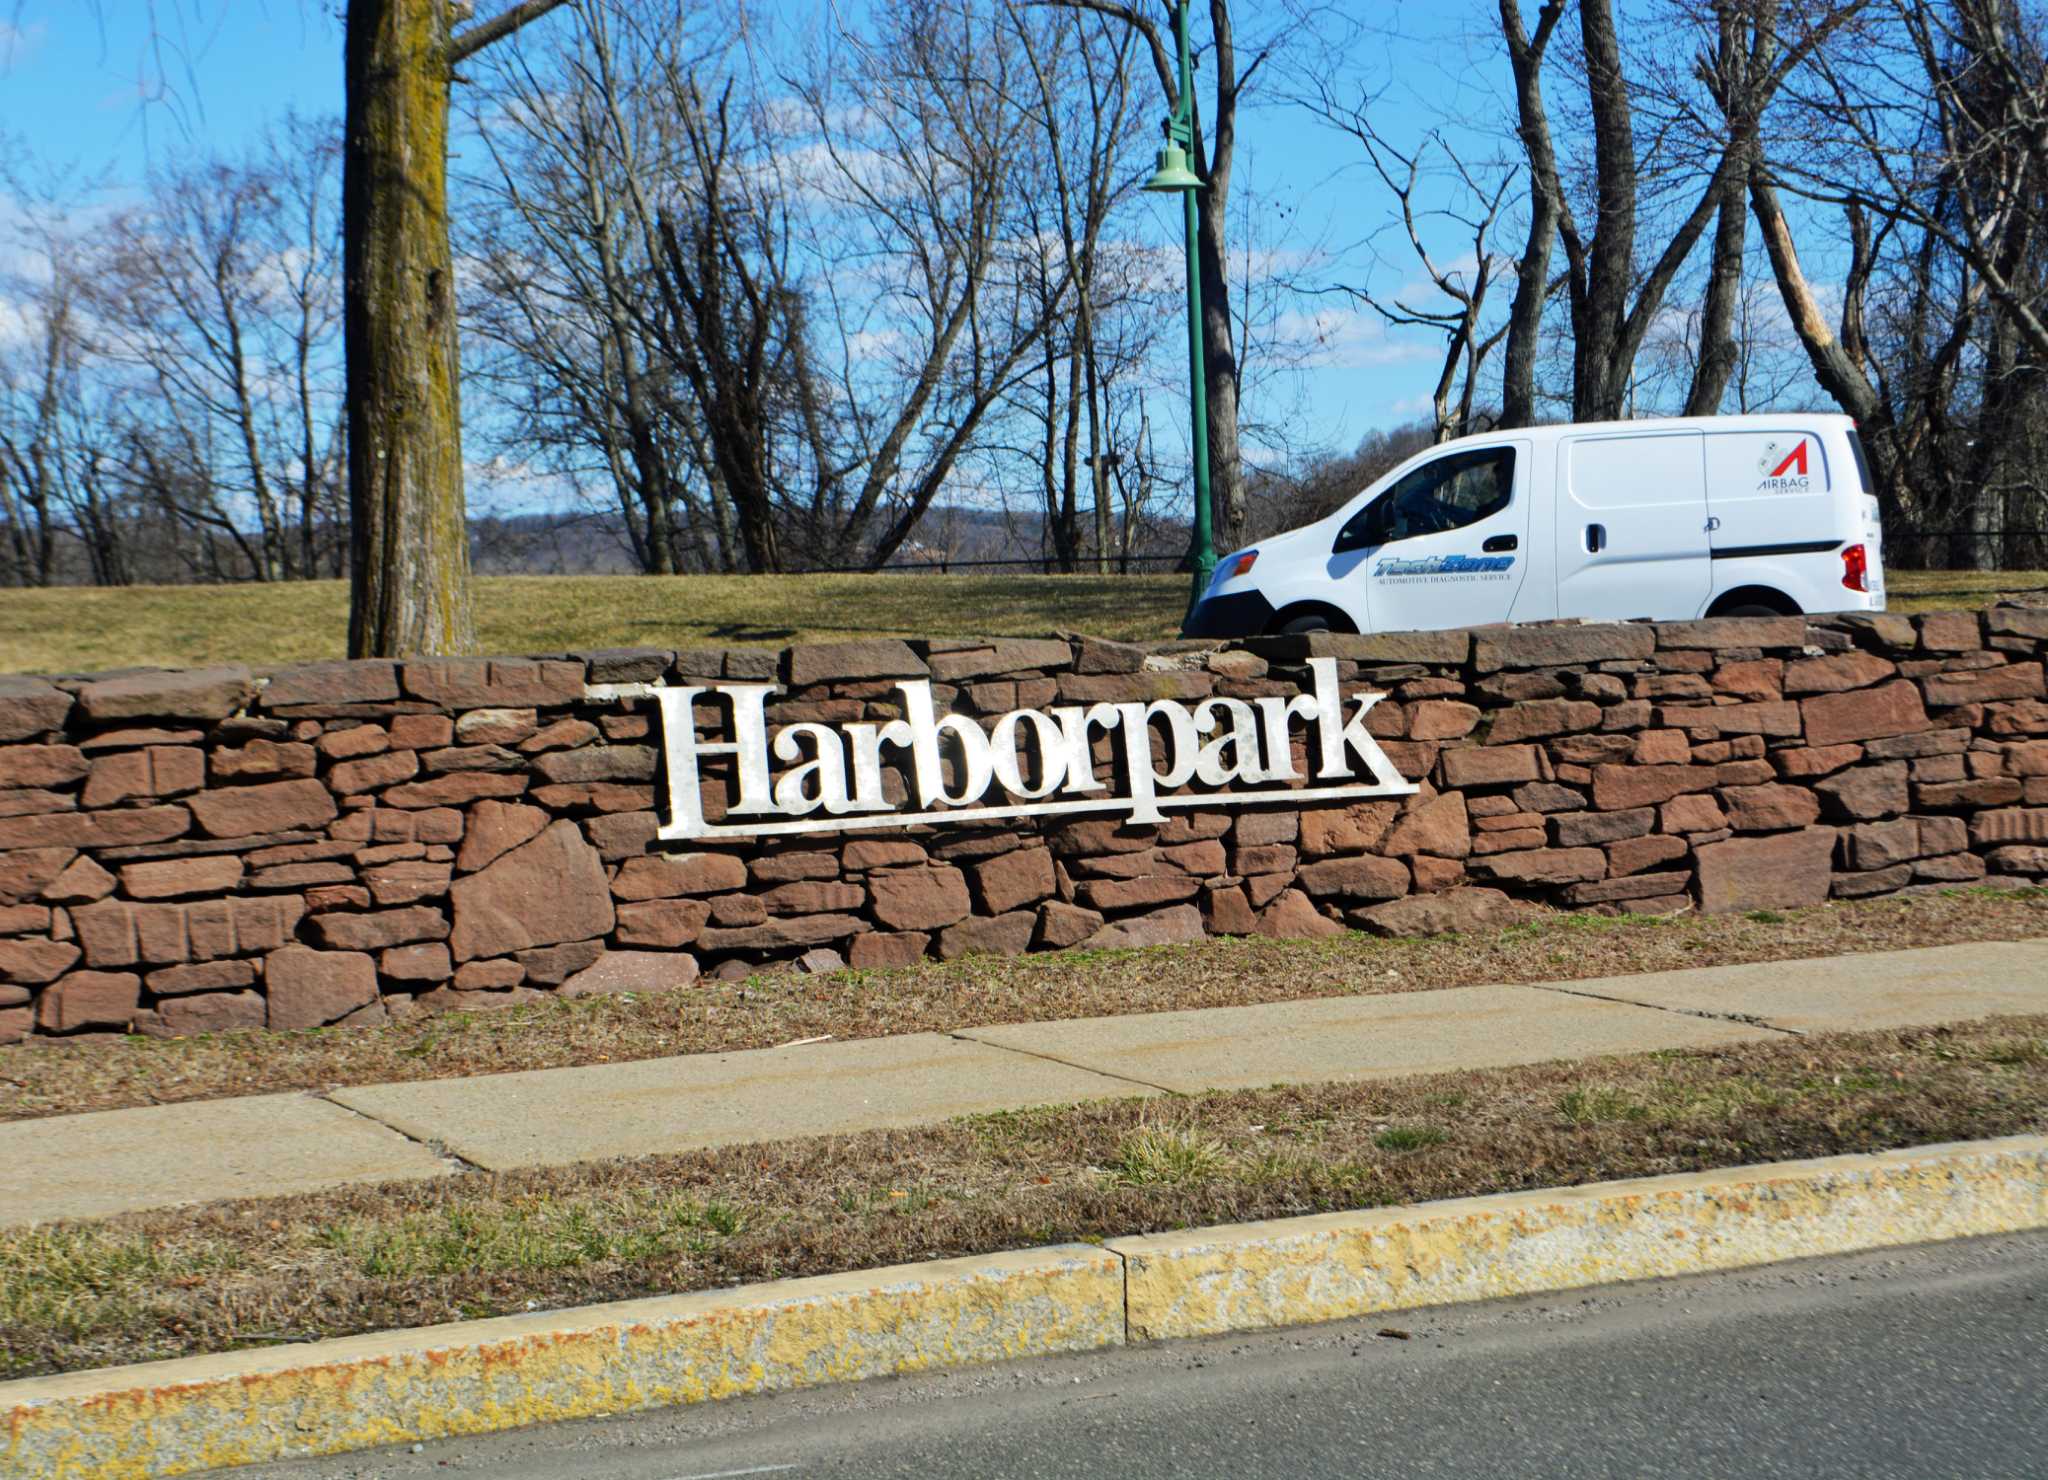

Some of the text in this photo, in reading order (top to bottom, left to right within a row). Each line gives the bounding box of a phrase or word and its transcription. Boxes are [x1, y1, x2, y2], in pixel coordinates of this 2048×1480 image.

[1757, 477, 1809, 490] AIRBAG
[1378, 574, 1512, 586] AUTOMOTIVE DIAGNOSTIC SERVICE
[653, 656, 1420, 841] Harborpark
